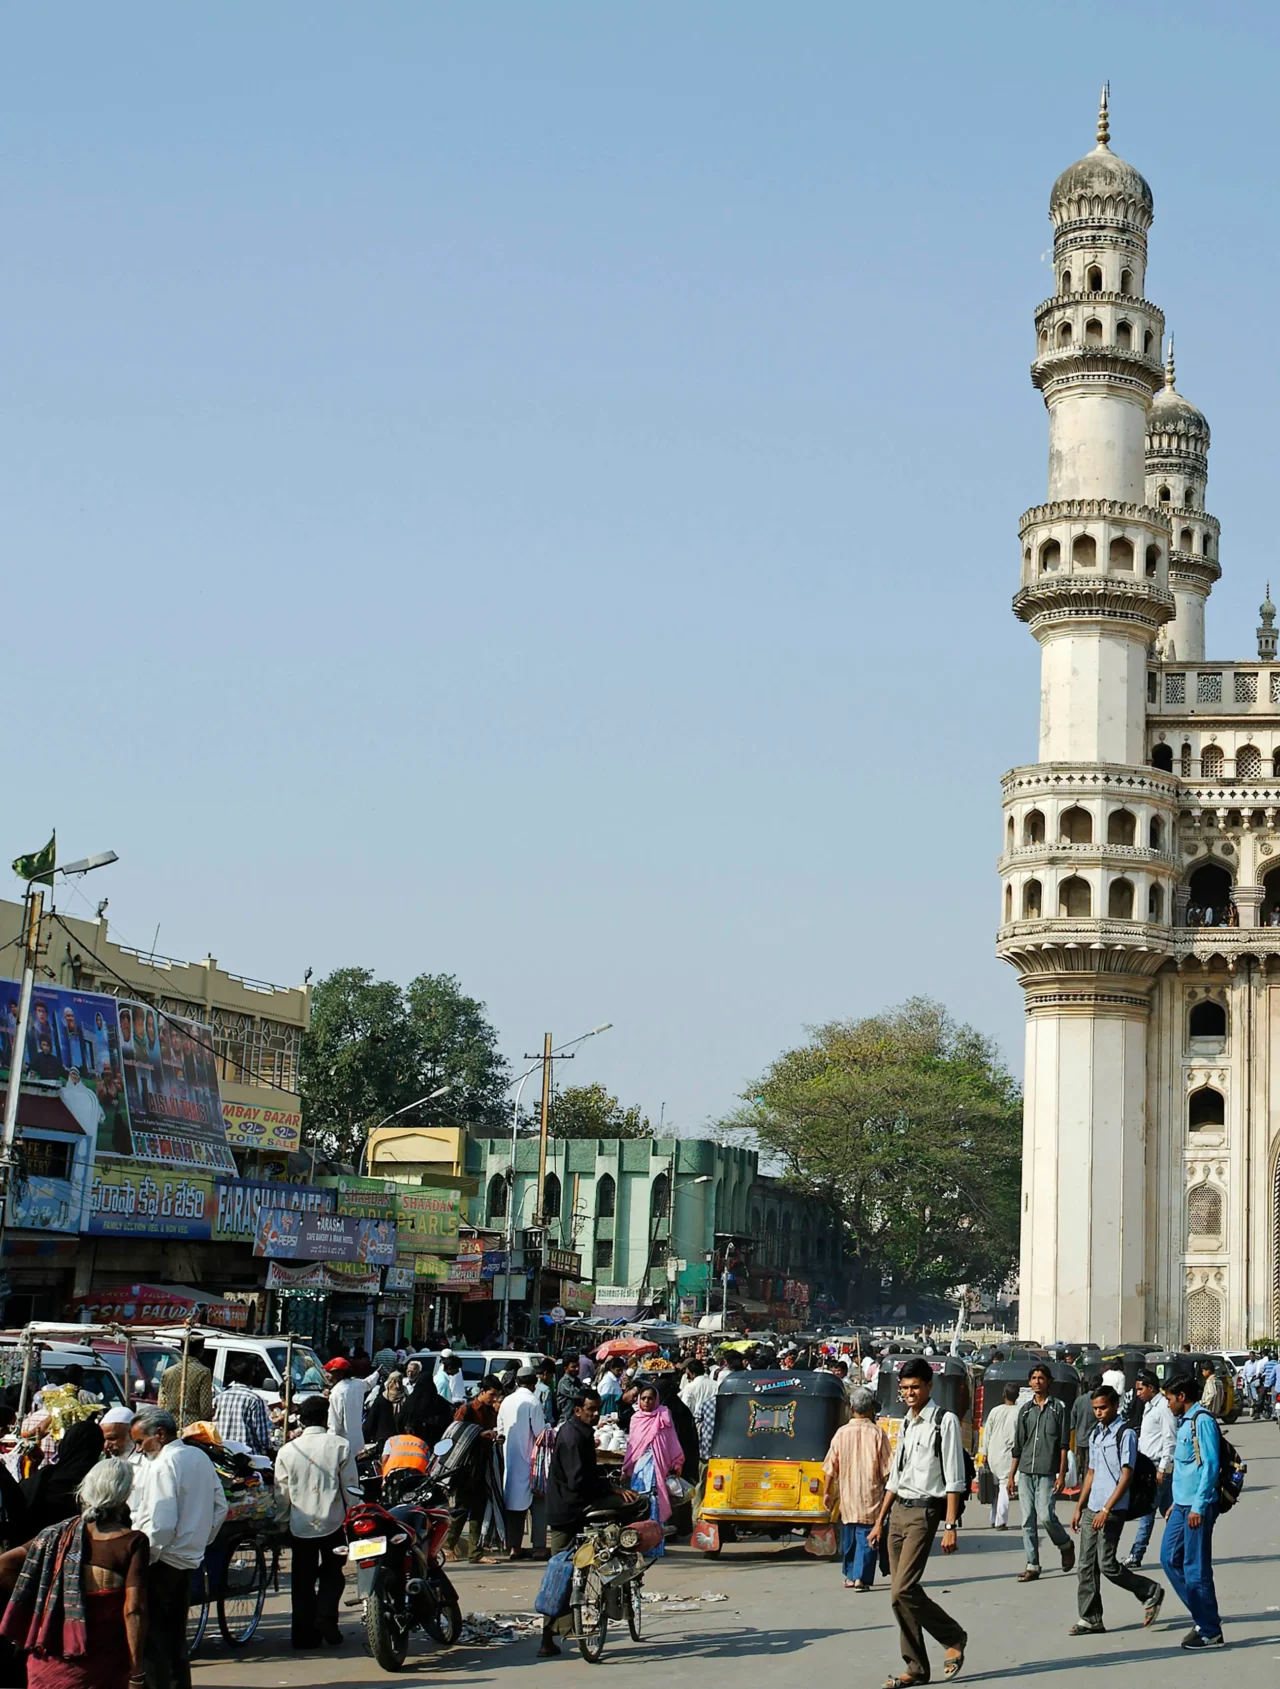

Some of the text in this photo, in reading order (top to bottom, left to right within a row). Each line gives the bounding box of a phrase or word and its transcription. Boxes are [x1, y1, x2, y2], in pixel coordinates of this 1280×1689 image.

[223, 1104, 300, 1128] MBAY BAZAR
[228, 1133, 296, 1149] TORY SALE
[345, 1188, 390, 1207] SHAADAN
[402, 1196, 454, 1212] SHAADAN
[397, 1211, 458, 1236] PEARLS
[278, 1234, 298, 1247] PEPSI
[376, 1243, 394, 1254] PEPSI
[141, 1304, 196, 1318] FALUDA
